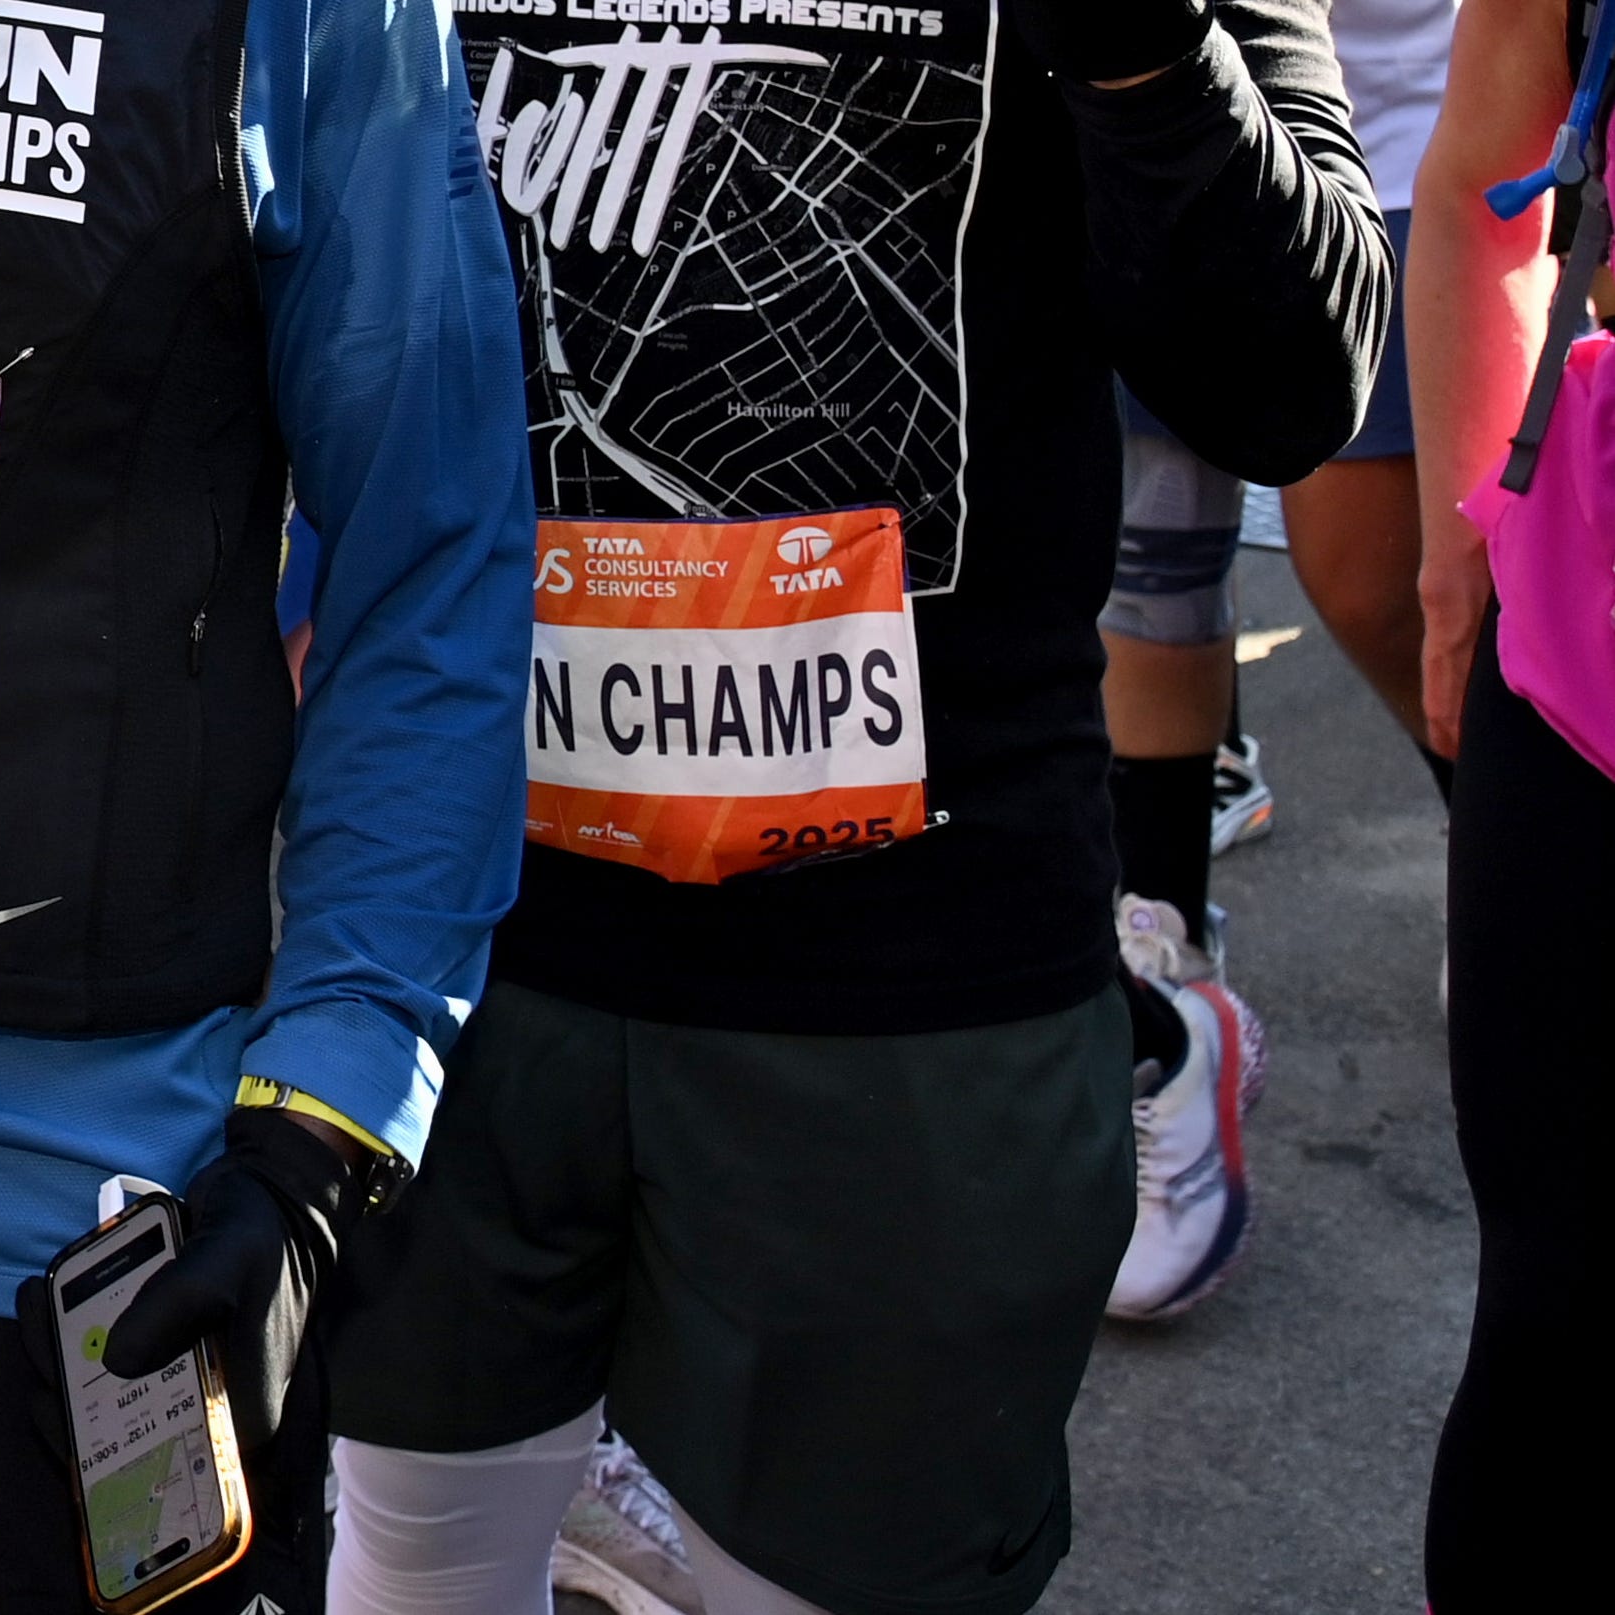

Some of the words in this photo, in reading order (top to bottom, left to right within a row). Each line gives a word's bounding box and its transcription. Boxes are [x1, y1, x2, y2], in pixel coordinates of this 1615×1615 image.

[727, 401, 815, 420] Hamilton
[820, 401, 851, 420] Hill
[583, 537, 645, 556] TATA
[584, 557, 729, 580] CONSULTANCY
[585, 579, 678, 598] SERVICES
[769, 567, 844, 596] TATA
[599, 647, 904, 759] CHAMPS
[165, 1394, 196, 1421] 26.54
